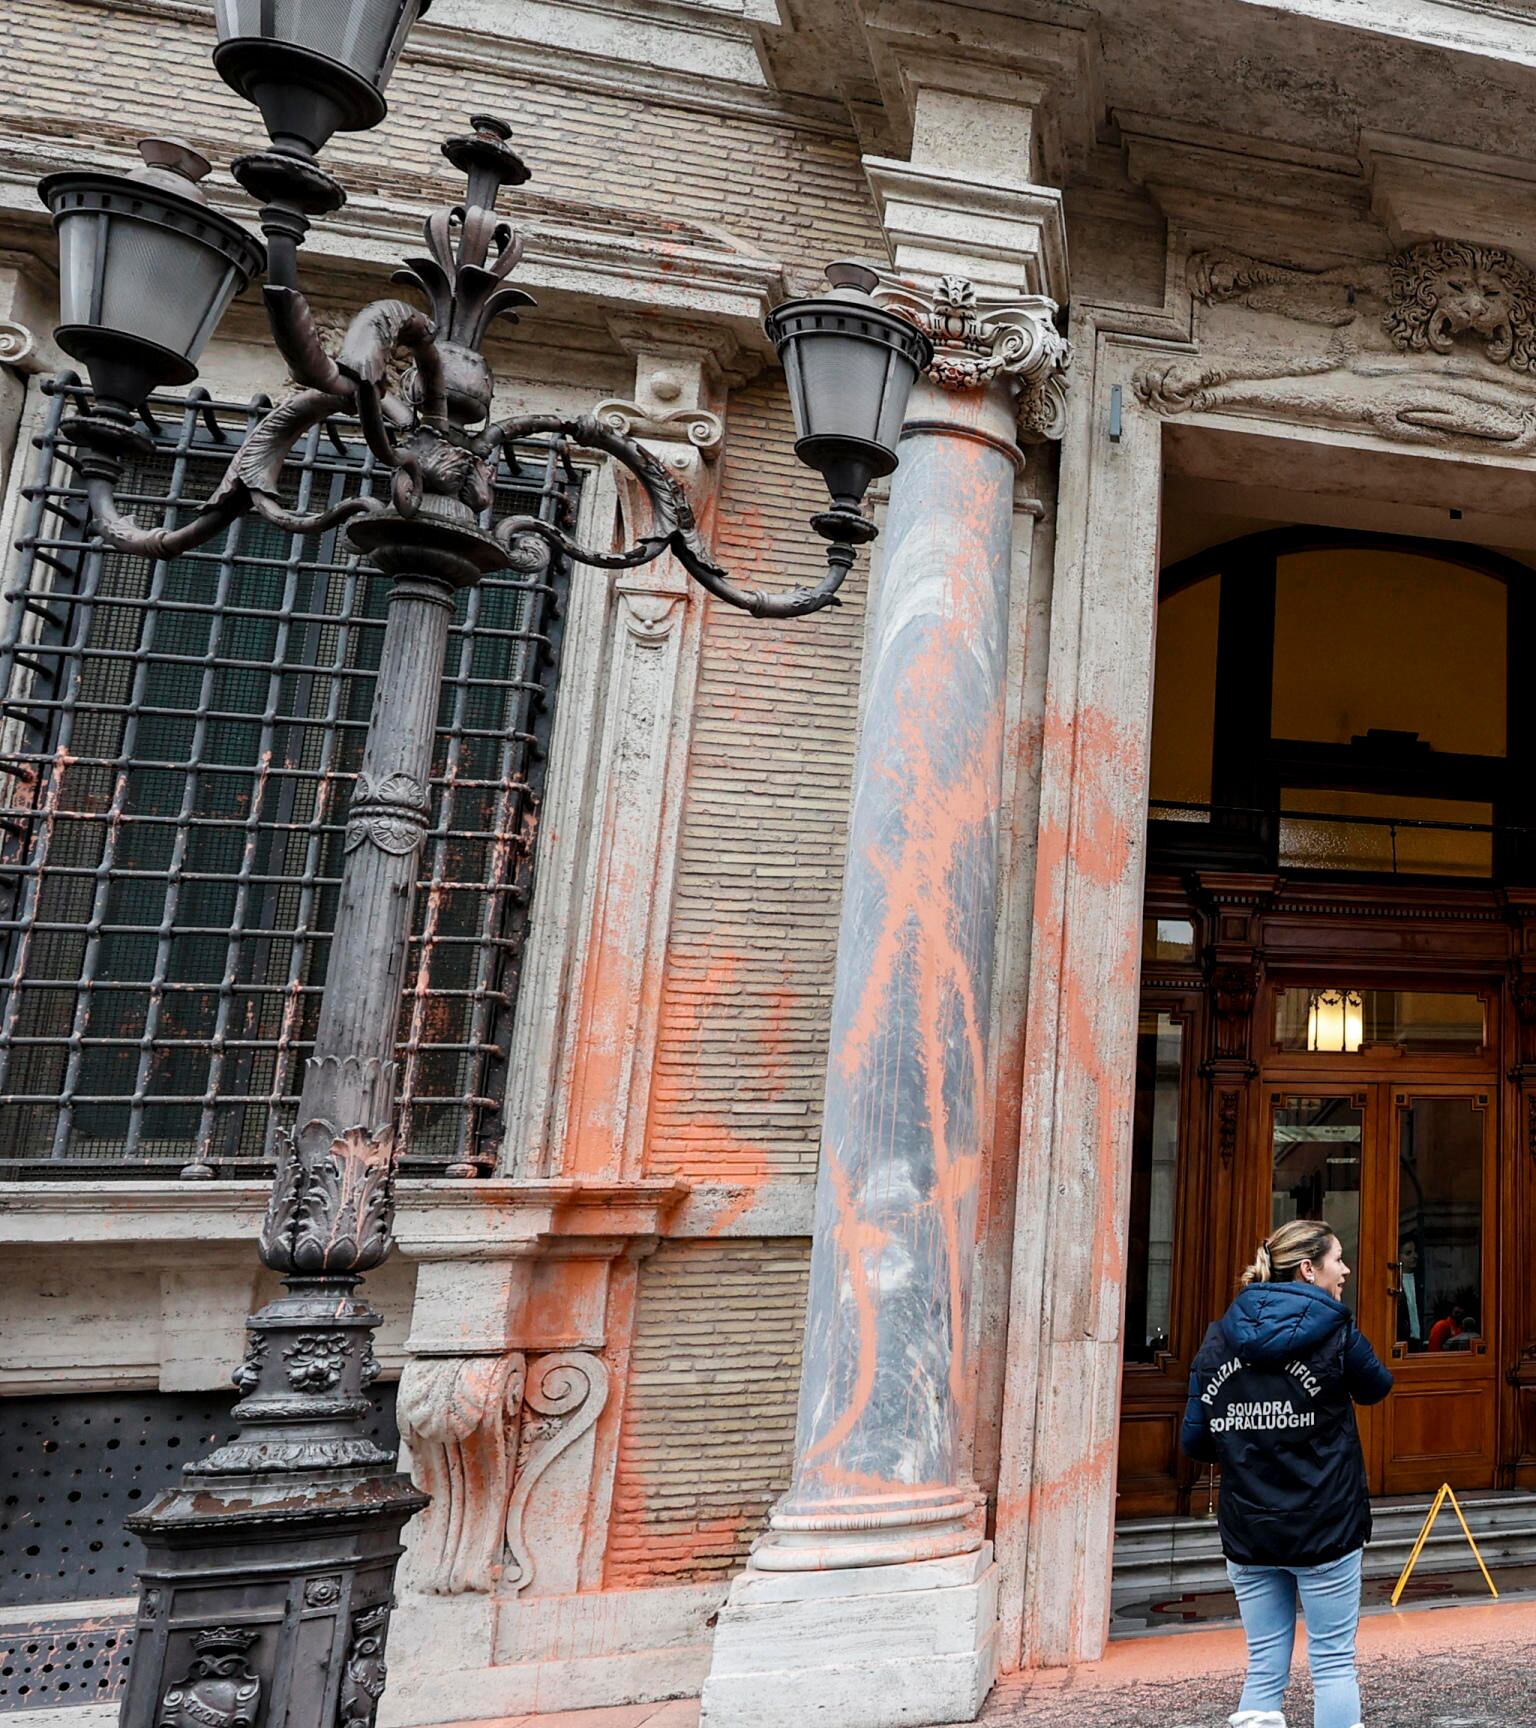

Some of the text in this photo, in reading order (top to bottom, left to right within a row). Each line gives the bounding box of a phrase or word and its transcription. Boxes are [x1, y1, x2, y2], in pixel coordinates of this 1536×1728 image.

[1200, 1356, 1242, 1406] POLIZIA
[1227, 1400, 1294, 1417] SQUADRA
[1209, 1412, 1315, 1433] SOPRALLUOGHI
